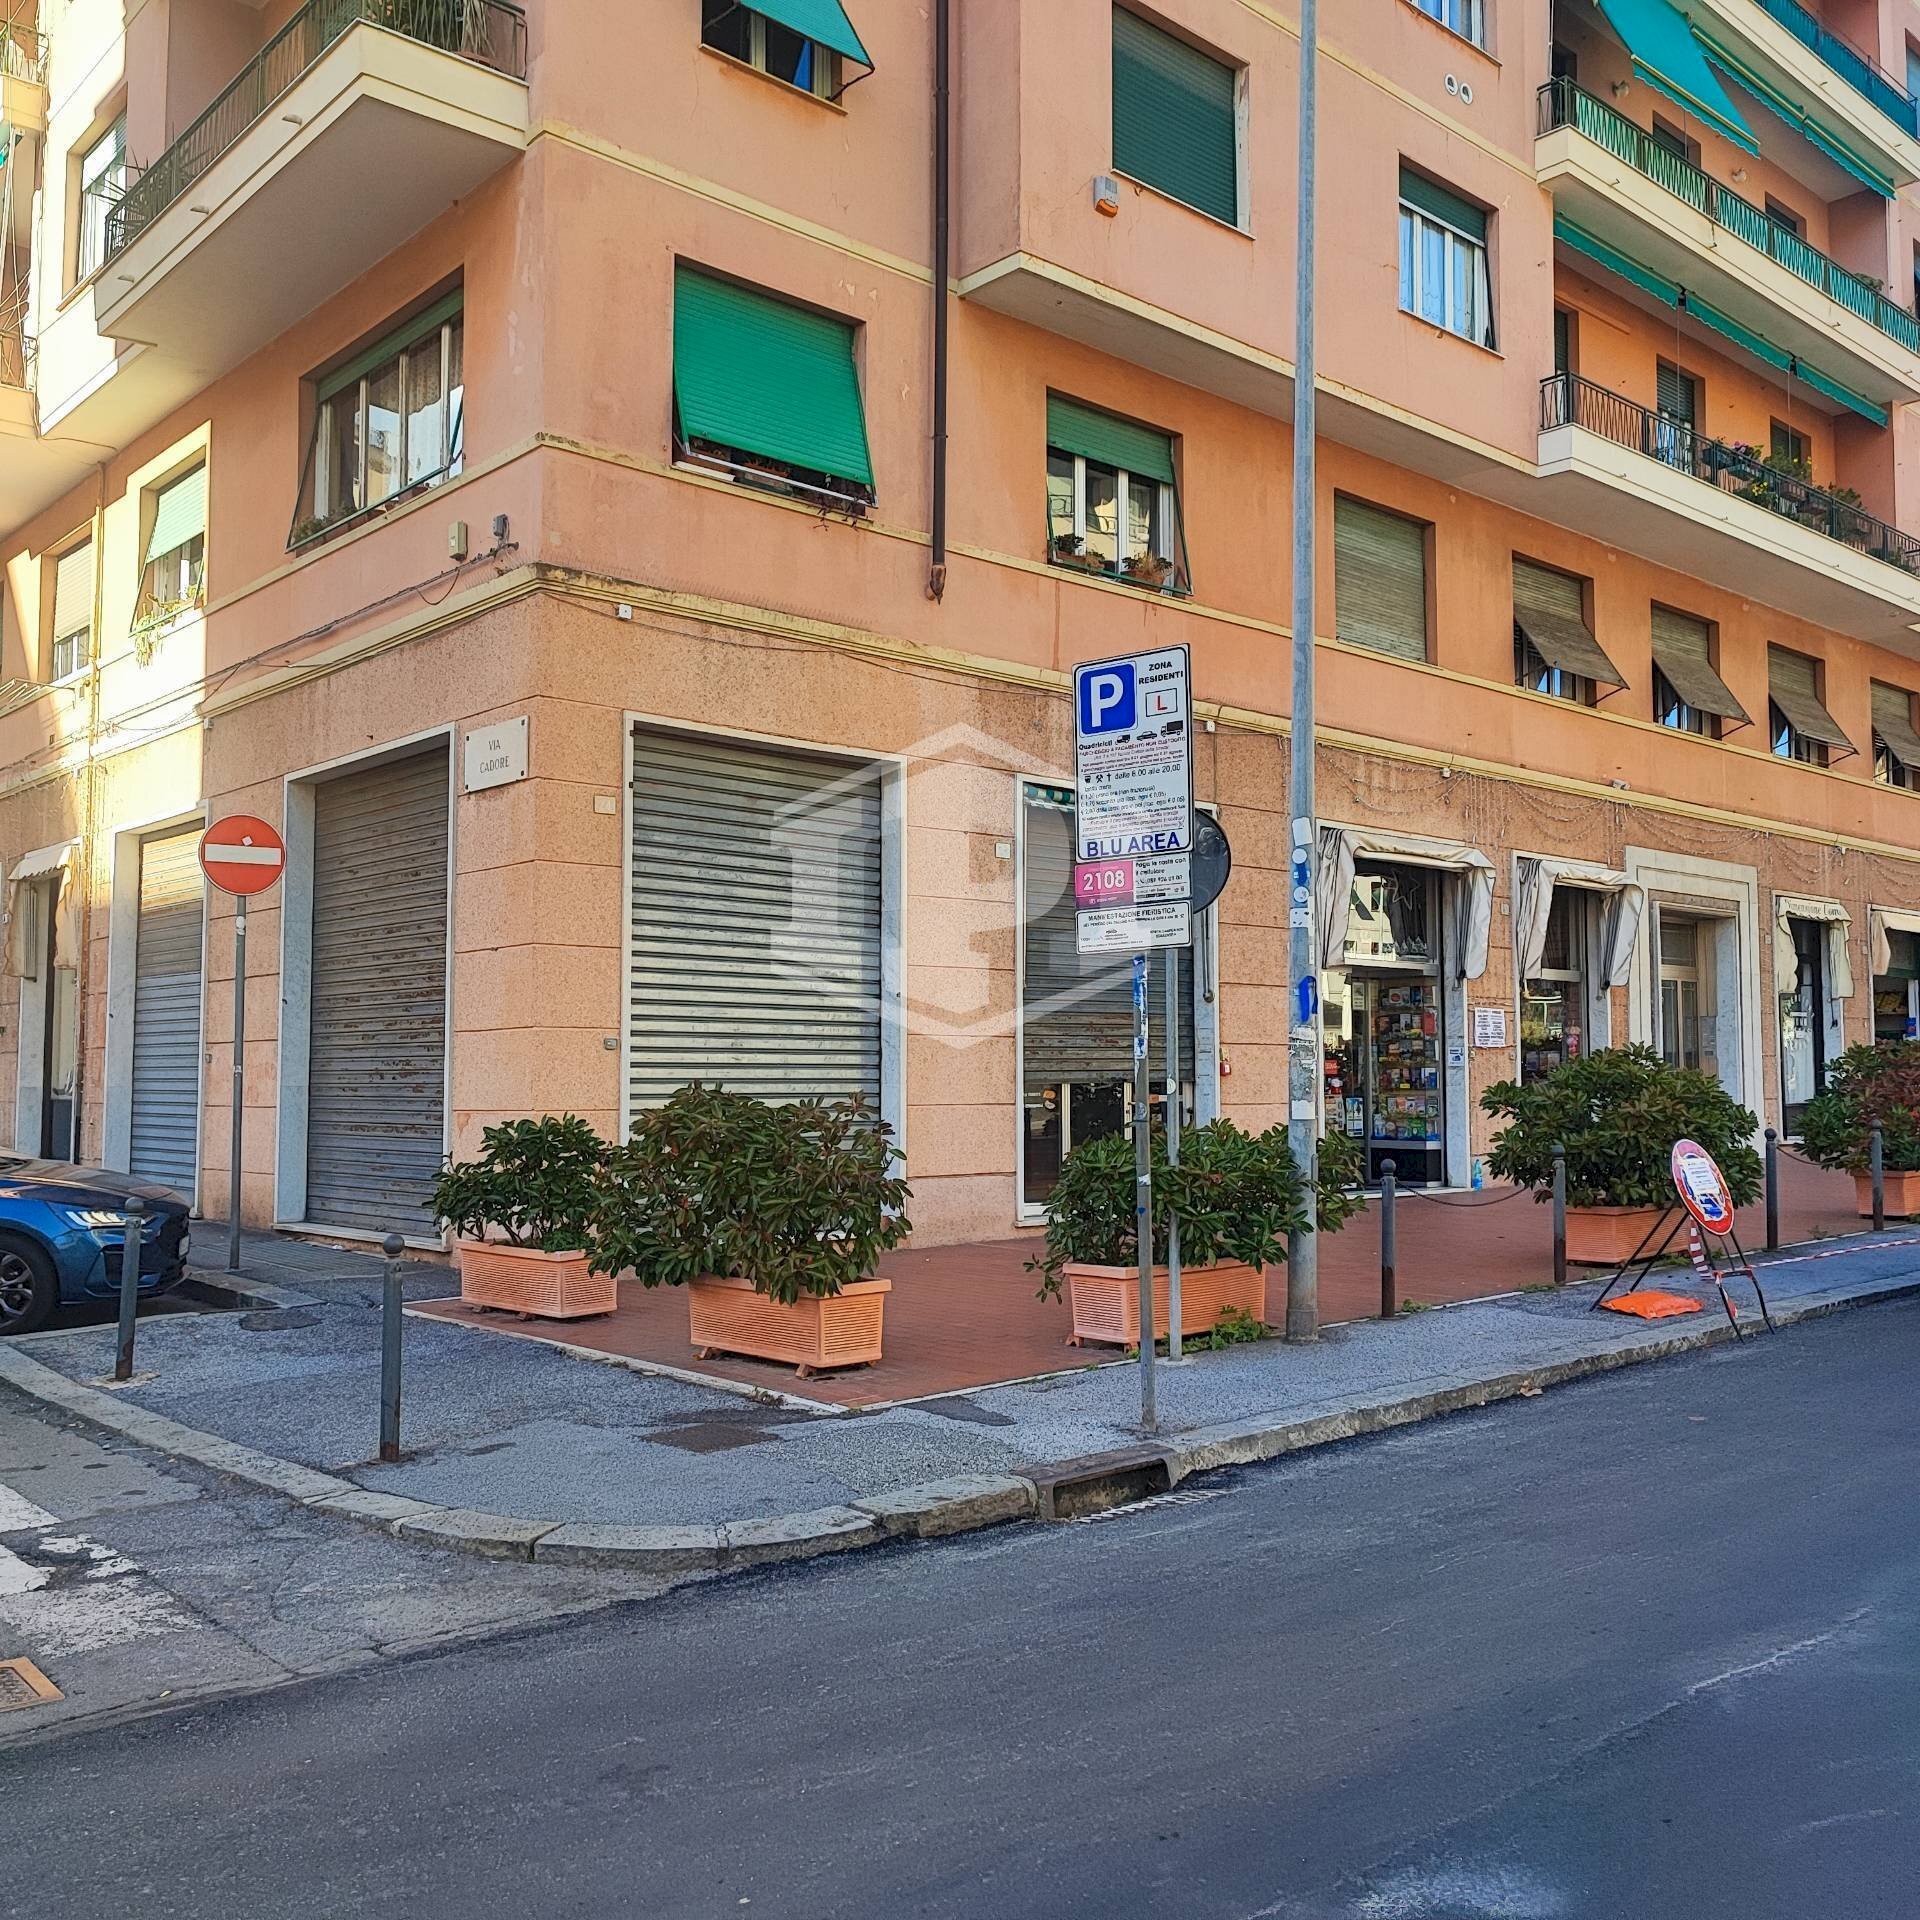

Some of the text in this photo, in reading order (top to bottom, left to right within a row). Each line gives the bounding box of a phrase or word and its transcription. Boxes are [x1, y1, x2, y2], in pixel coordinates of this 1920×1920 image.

[1149, 661, 1172, 671] ZONA
[1139, 671, 1184, 685] RESIDENTI
[1090, 673, 1124, 728] P
[1157, 695, 1168, 711] L
[488, 739, 501, 751] VIA
[480, 756, 510, 774] CADORE
[1086, 831, 1180, 857] BLU AREA
[1083, 870, 1125, 891] 2108
[1088, 910, 1141, 921] MANIFESTAZIONE
[1142, 907, 1176, 917] FIERISTICA
